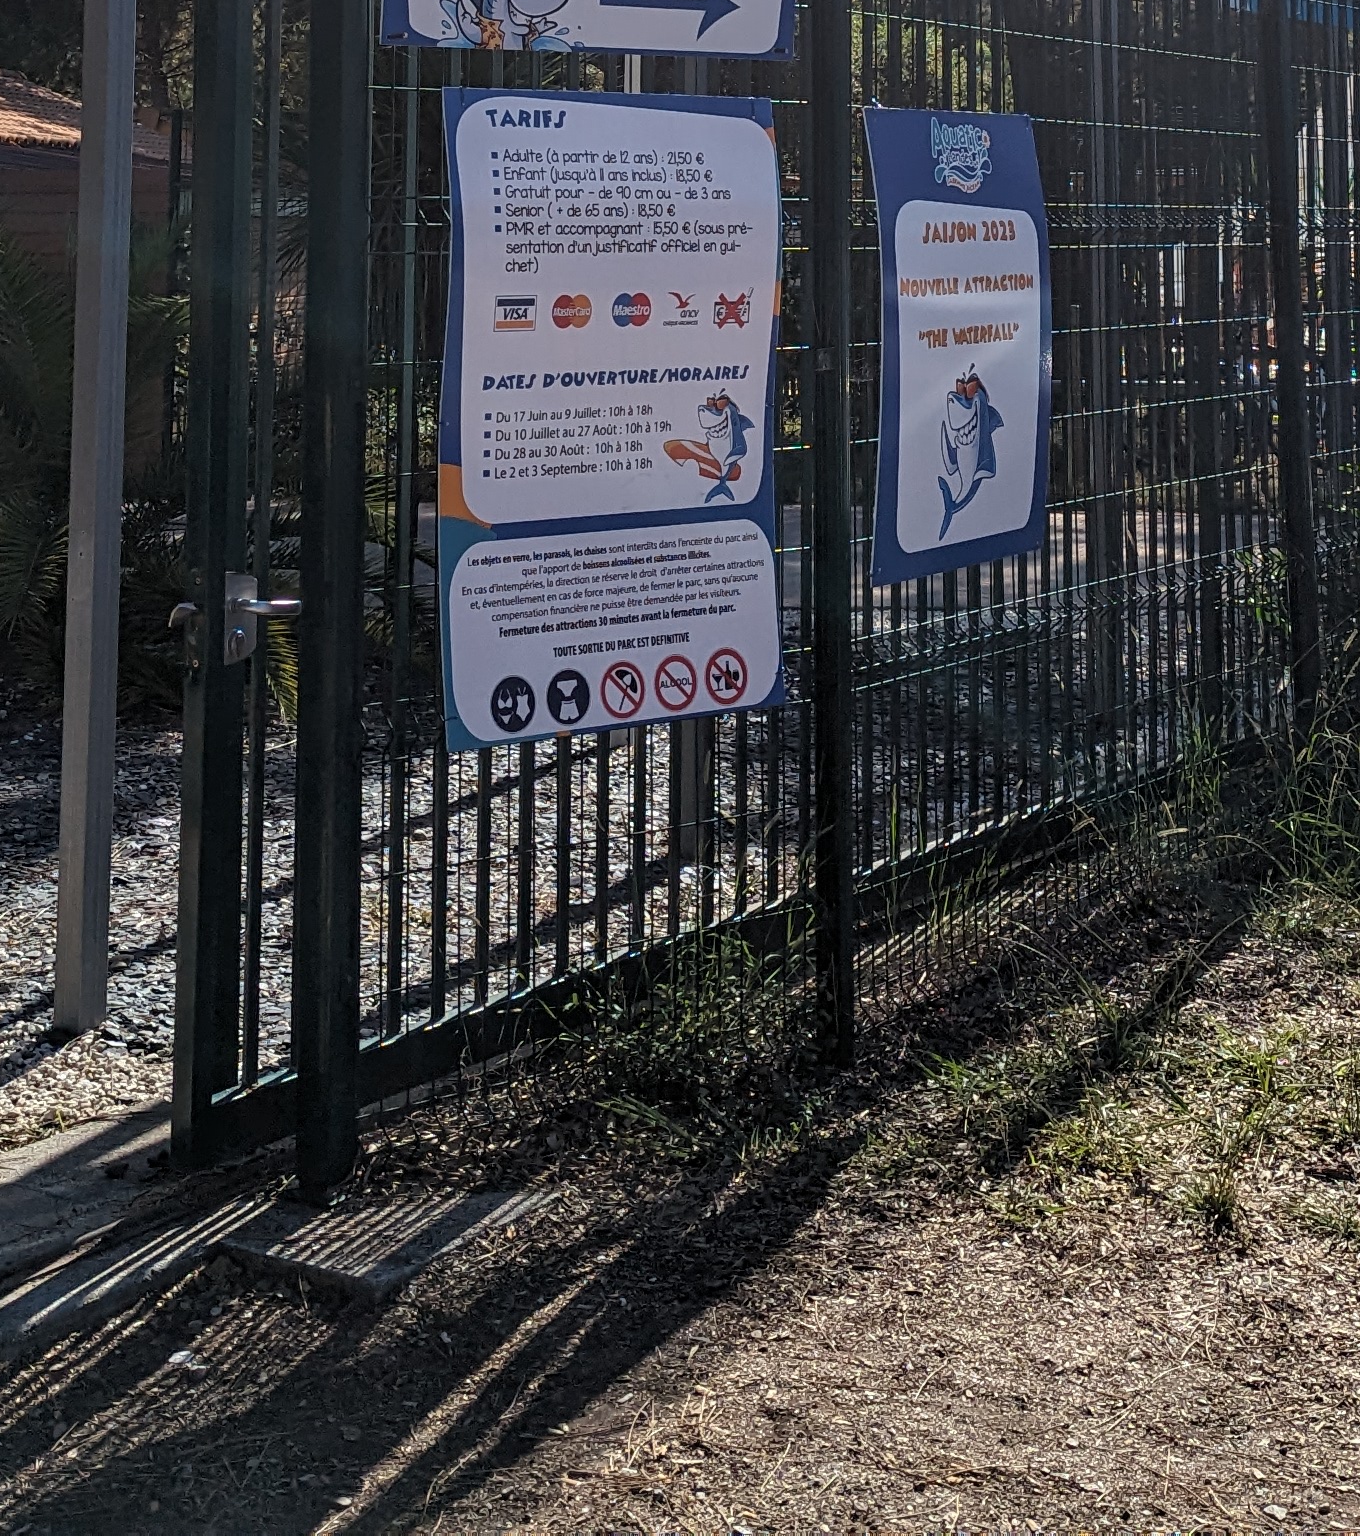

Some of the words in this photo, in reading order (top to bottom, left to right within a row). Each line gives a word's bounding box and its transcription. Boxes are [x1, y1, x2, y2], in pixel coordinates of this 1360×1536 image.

[485, 108, 566, 128] TARIFS
[502, 148, 544, 163] Adulte
[546, 147, 560, 164] (à
[562, 149, 600, 166] partir
[602, 150, 617, 164] de
[620, 150, 630, 164] 12
[633, 149, 658, 166] ans)
[696, 152, 704, 165] €
[504, 166, 547, 181] Enfant
[550, 165, 596, 184] (jusqu'à
[608, 170, 629, 182] ans
[632, 167, 666, 184] inclus)
[676, 168, 700, 184] 18,50
[704, 170, 713, 182] €
[505, 184, 552, 199] Gratuit
[554, 188, 584, 202] pour
[598, 185, 613, 200] de
[616, 186, 632, 200] 90
[634, 188, 653, 200] cm
[656, 189, 672, 200] ou
[684, 186, 698, 200] de
[700, 186, 708, 200] 3
[712, 190, 731, 200] ans
[506, 203, 544, 217] Senior
[566, 204, 582, 217] de
[585, 203, 600, 217] 65
[603, 202, 628, 218] ans)
[638, 203, 664, 219] 18,50
[666, 204, 676, 217] €
[506, 221, 534, 236] PMR
[538, 222, 552, 236] et
[555, 222, 644, 238] accompagnant
[653, 221, 678, 237] 15,50
[682, 221, 691, 235] €
[694, 220, 724, 236] (sous
[728, 222, 754, 238] pré-
[922, 222, 977, 244] SAISON
[982, 220, 1016, 242] 2023
[506, 240, 564, 254] sentation
[568, 240, 592, 254] d'un
[592, 238, 658, 256] justificatif
[660, 238, 700, 252] officiel
[704, 242, 717, 252] en
[720, 240, 742, 255] gui-
[505, 256, 539, 274] chet)
[900, 276, 959, 298] NOUVELLE
[964, 274, 1034, 294] ATTRACTION
[502, 307, 529, 320] VISA
[612, 304, 650, 316] Maestro
[482, 374, 536, 391] DATES
[542, 364, 750, 388] D'OUVERTURE/HORAIRES
[496, 412, 510, 424] Du
[513, 410, 526, 422] 17
[527, 410, 548, 422] Juin
[550, 412, 562, 420] au
[564, 408, 572, 420] 9
[572, 407, 601, 420] Juillet
[608, 406, 626, 418] 10h
[628, 404, 634, 416] à
[636, 404, 653, 416] 18h
[496, 430, 510, 442] Du
[514, 428, 527, 440] 10
[528, 426, 560, 440] Juillet
[562, 428, 575, 438] au
[578, 425, 590, 437] 27
[592, 424, 618, 436] Août
[625, 422, 642, 434] 10h
[645, 422, 651, 433] à
[654, 420, 672, 432] 19h
[494, 448, 510, 460] Du
[512, 447, 526, 460] 28
[528, 448, 542, 458] au
[544, 446, 558, 458] 30
[560, 444, 584, 456] Août
[595, 441, 614, 454] 10h
[616, 440, 622, 452] à
[624, 440, 642, 452] 18h
[494, 467, 507, 480] Le
[509, 466, 516, 478] 2
[518, 466, 530, 478] et
[532, 465, 538, 477] 3
[540, 460, 598, 478] Septembre
[605, 458, 624, 472] 10h
[626, 458, 632, 470] à
[634, 457, 653, 470] 18h
[499, 626, 540, 638] Fermeture
[541, 622, 554, 633] des
[556, 618, 598, 630] attractions
[599, 616, 608, 626] 30
[609, 614, 639, 625] minutes
[553, 645, 578, 658] TOUTE
[578, 642, 604, 655] SORTIE
[606, 640, 616, 652] DU
[618, 638, 636, 650] PARC
[637, 636, 649, 648] EST
